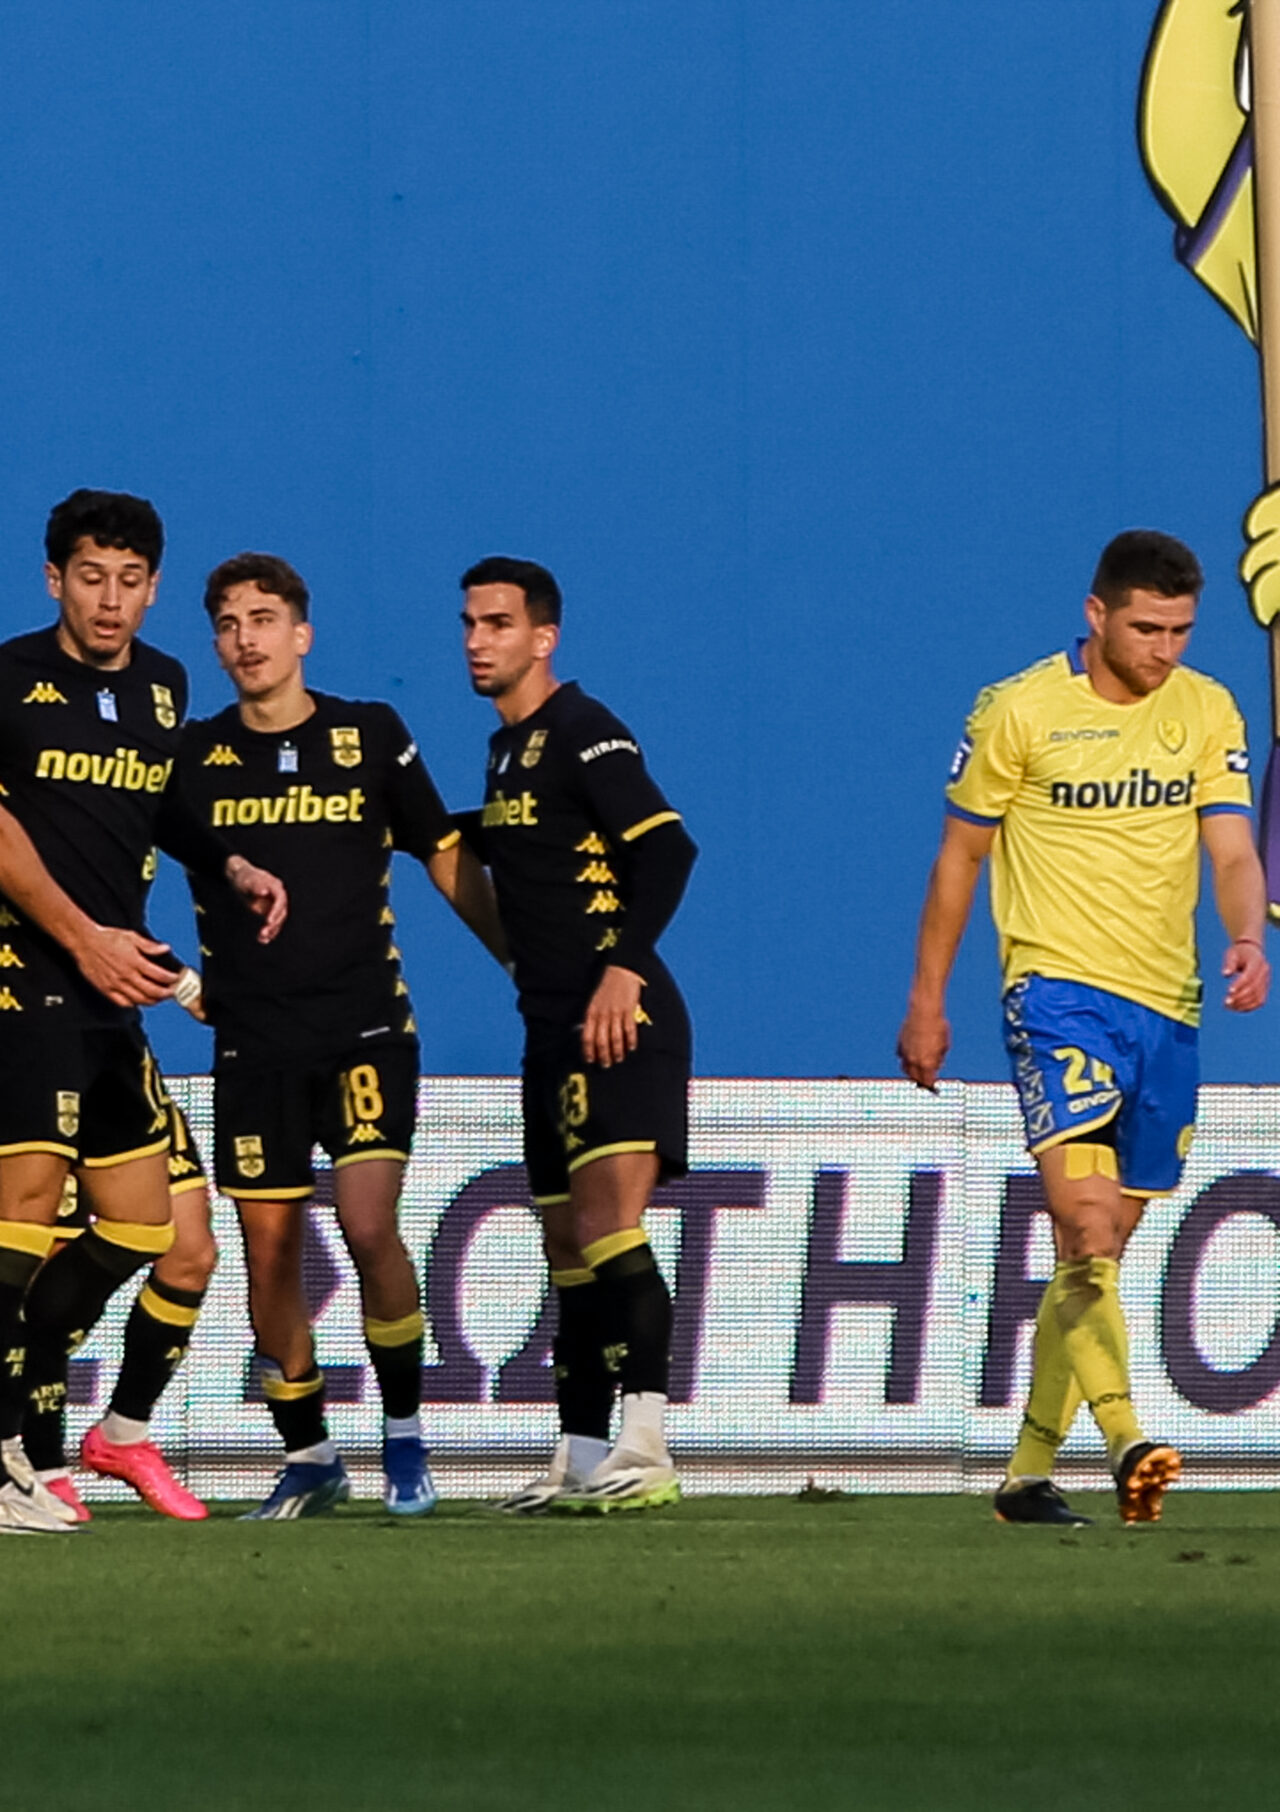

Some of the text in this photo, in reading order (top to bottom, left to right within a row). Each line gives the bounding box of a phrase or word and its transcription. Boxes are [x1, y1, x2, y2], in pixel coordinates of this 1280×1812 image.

[213, 786, 366, 826] novibet
[1051, 769, 1197, 808] novibet
[339, 1064, 384, 1127] 18
